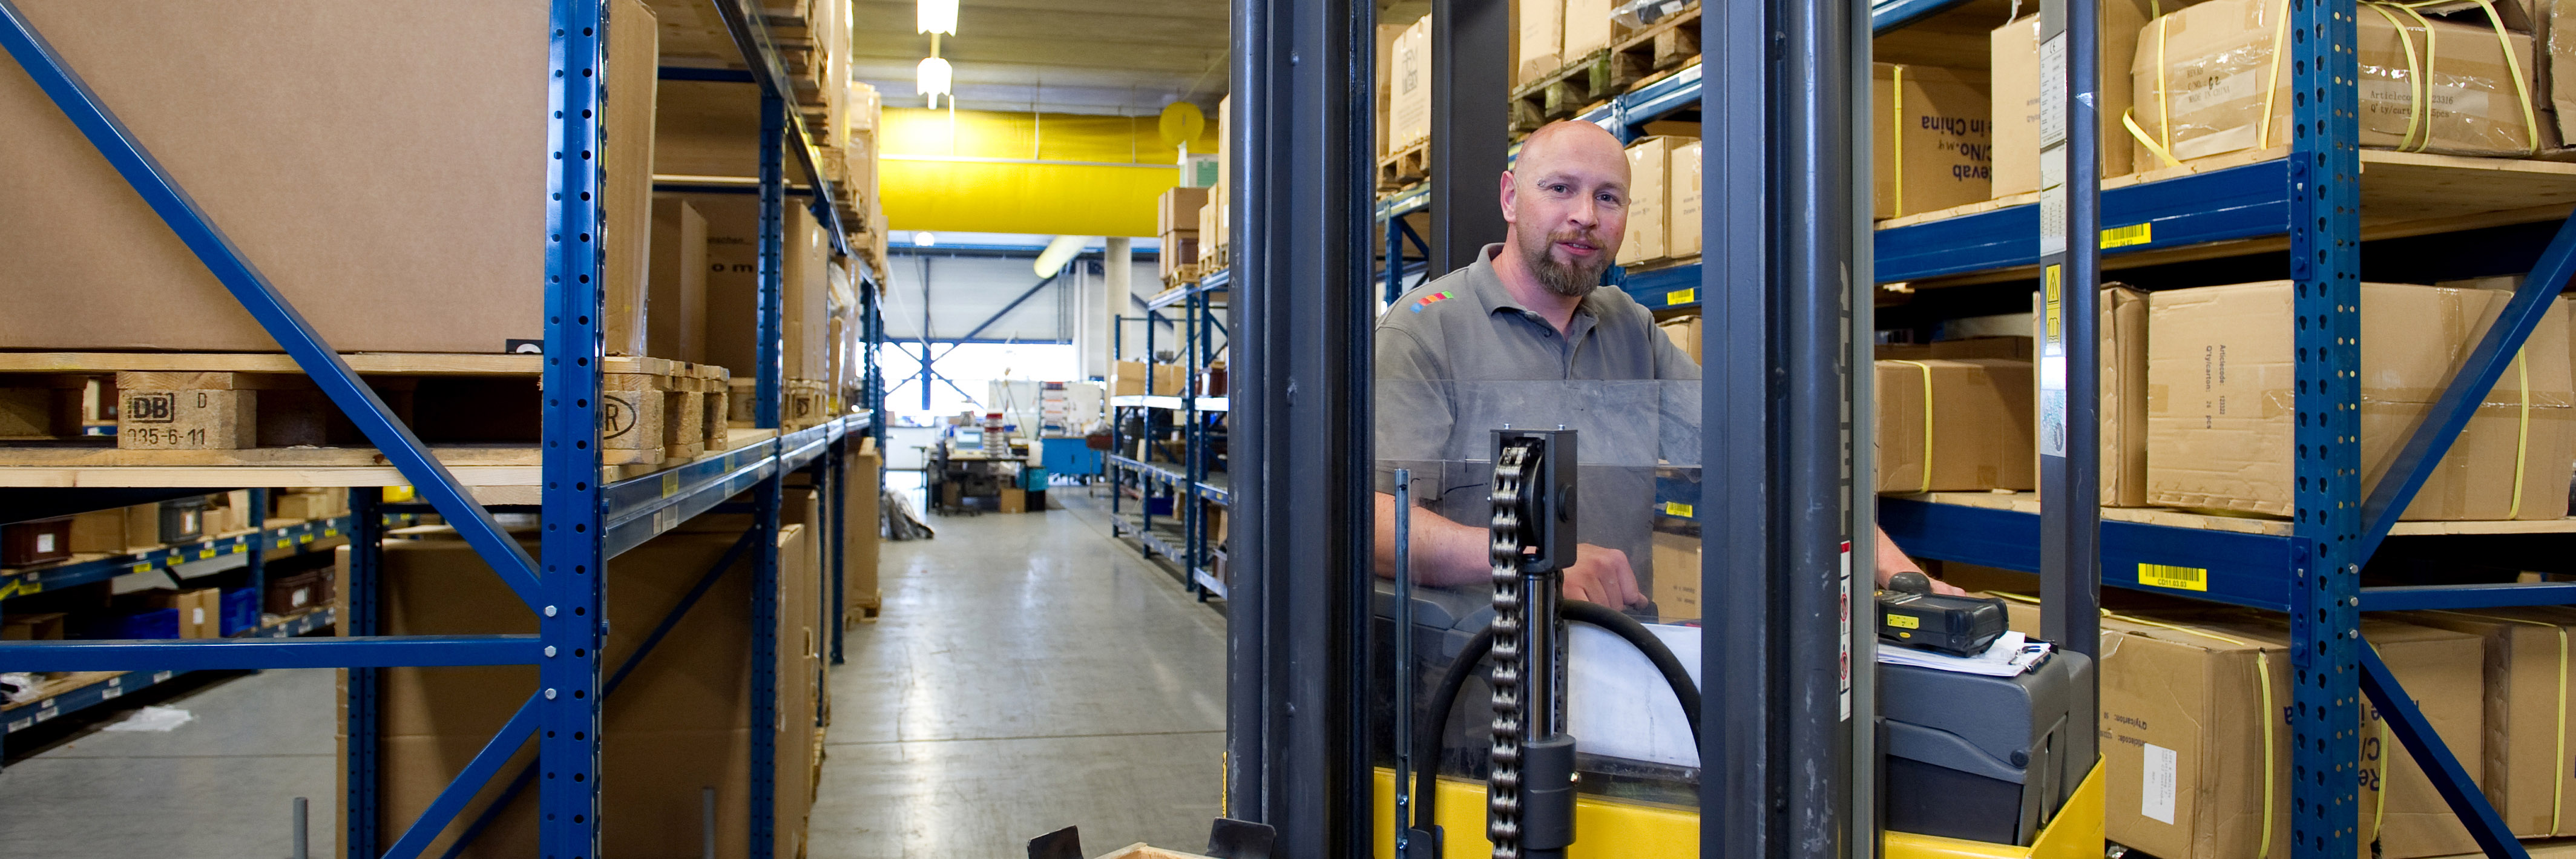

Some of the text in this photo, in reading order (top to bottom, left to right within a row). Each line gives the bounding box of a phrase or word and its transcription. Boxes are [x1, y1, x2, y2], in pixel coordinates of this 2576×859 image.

[2370, 90, 2454, 105] Articleco 23316
[2431, 108, 2450, 119] 5pcs
[1921, 115, 1966, 136] China
[1953, 164, 1991, 183] evab
[133, 392, 207, 418] DB D
